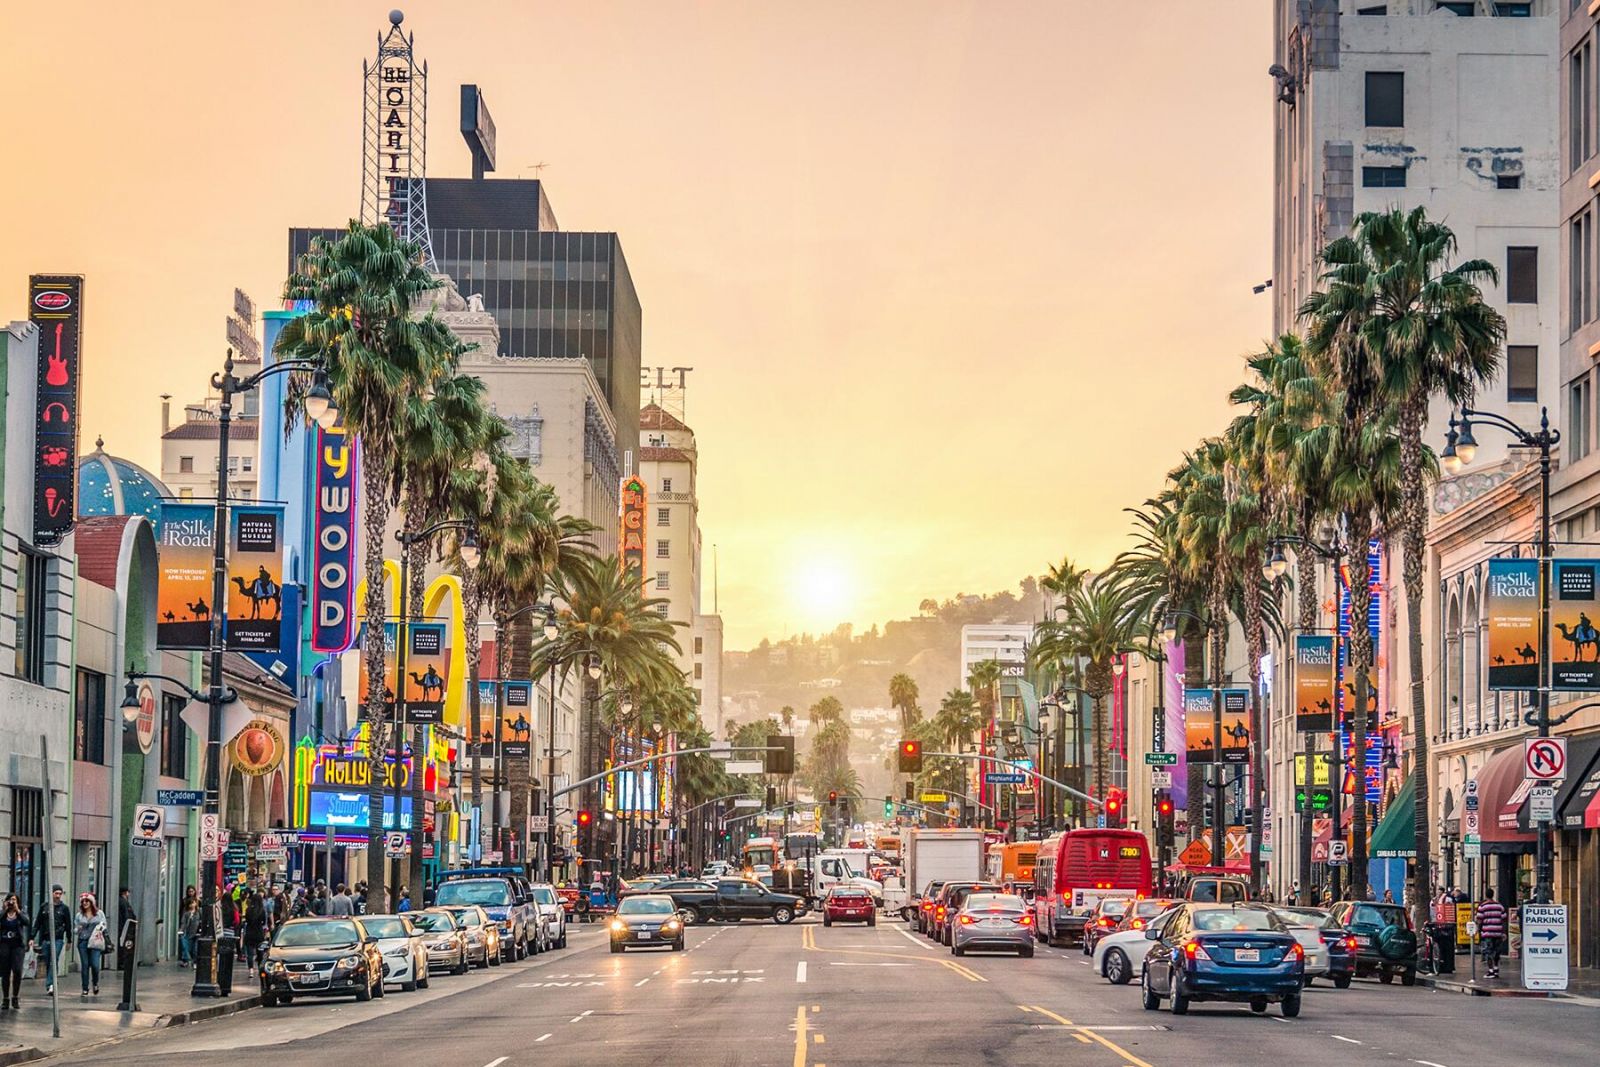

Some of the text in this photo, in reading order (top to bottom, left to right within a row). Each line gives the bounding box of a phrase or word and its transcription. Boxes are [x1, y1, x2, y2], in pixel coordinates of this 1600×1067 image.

[181, 520, 207, 536] Silk
[169, 530, 212, 547] Road
[1507, 572, 1532, 586] Silk
[1497, 580, 1536, 597] Road
[1310, 646, 1328, 657] Silk
[1302, 653, 1331, 665] Road
[1189, 701, 1213, 712] Road
[988, 775, 1013, 783] Highland
[159, 791, 196, 800] McCadden
[262, 836, 281, 845] ATM
